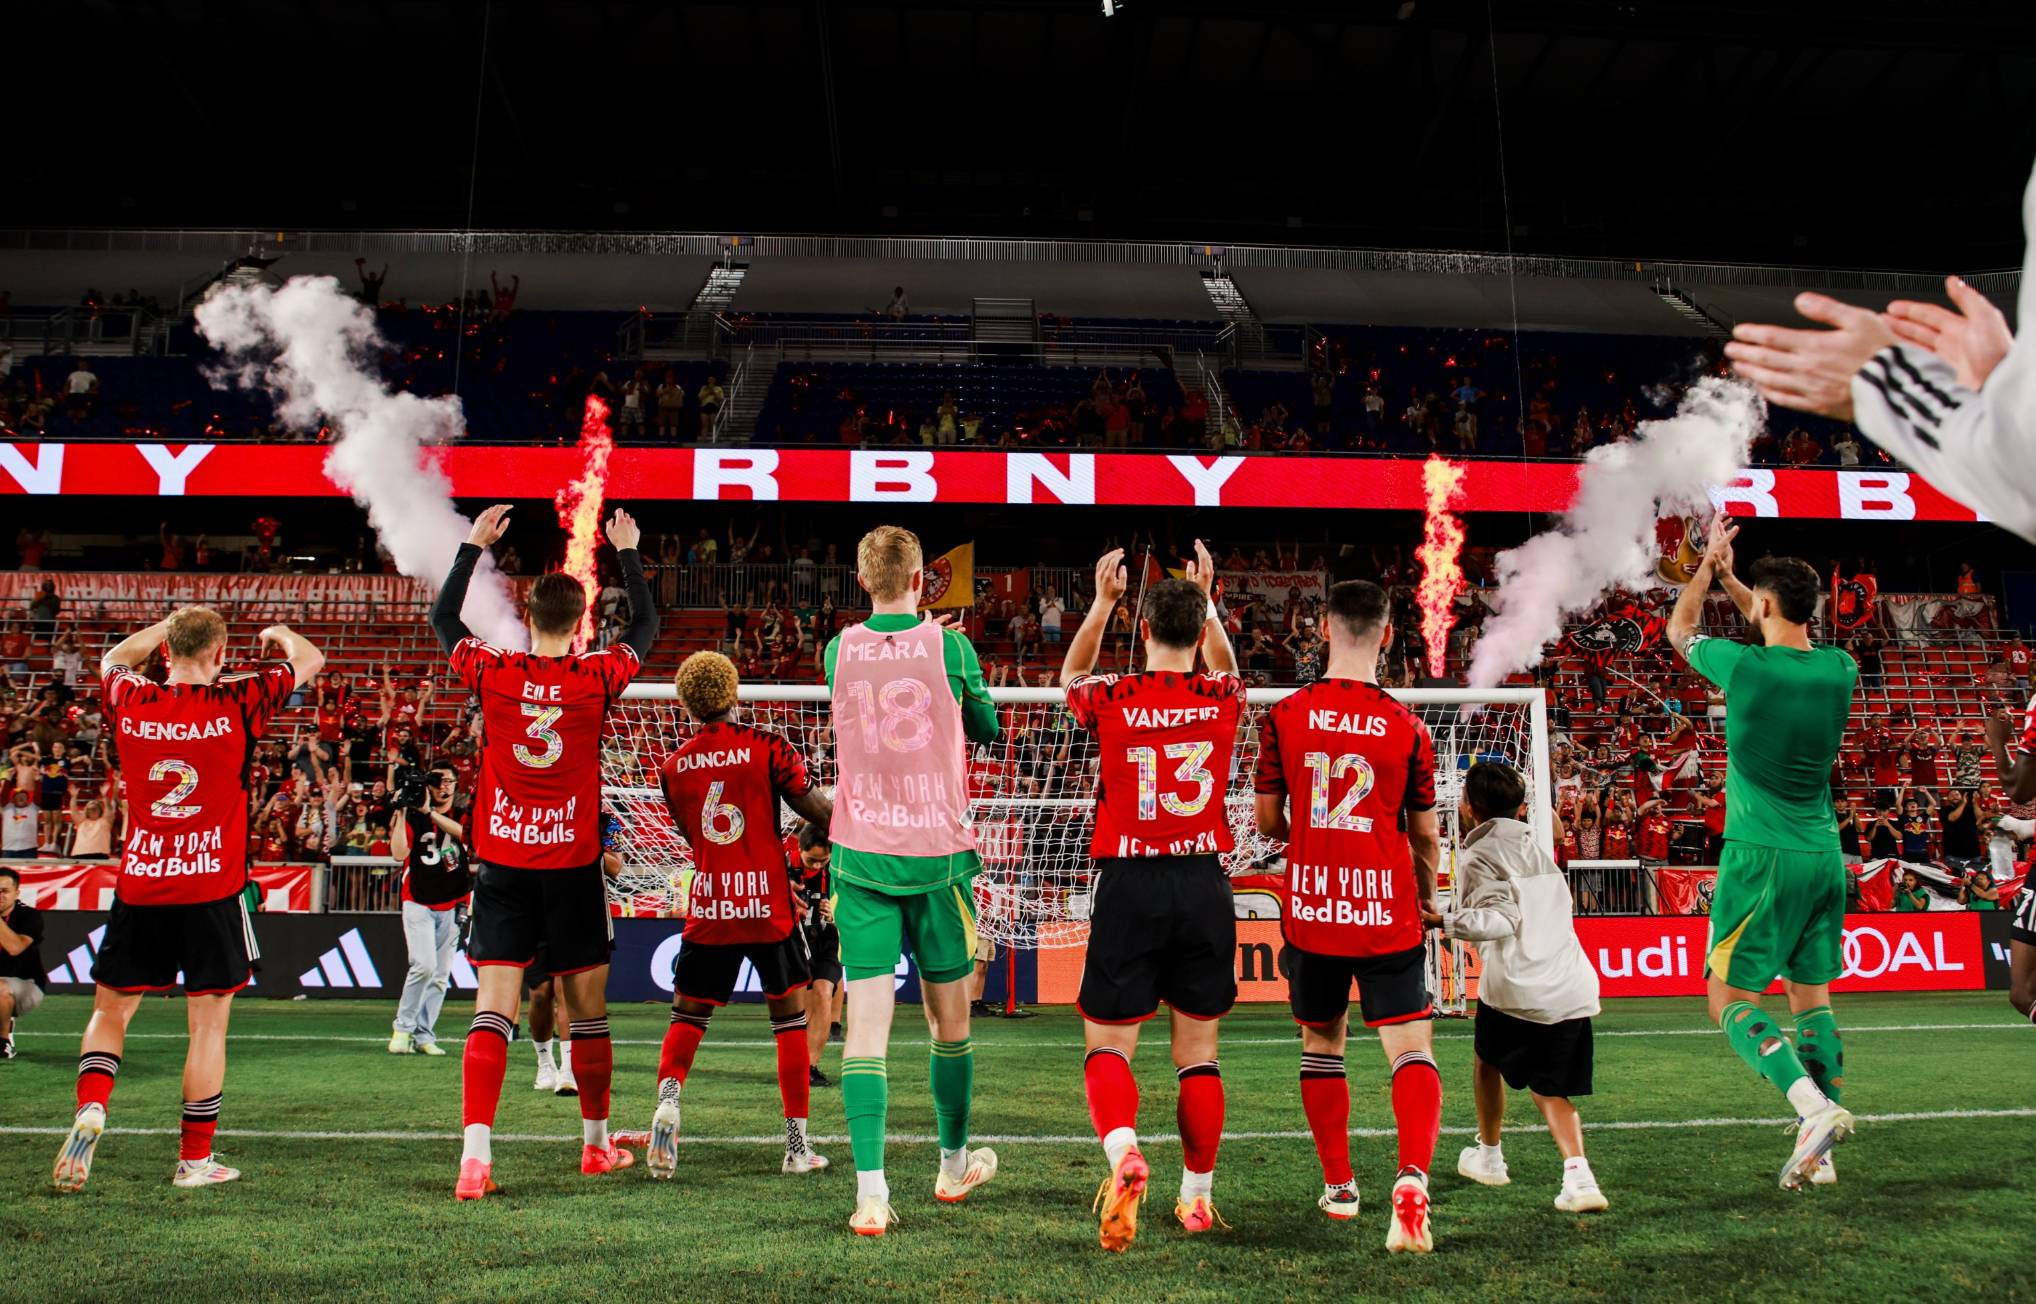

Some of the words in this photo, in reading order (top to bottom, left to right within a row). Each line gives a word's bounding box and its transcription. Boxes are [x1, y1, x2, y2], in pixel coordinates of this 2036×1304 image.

[1706, 468, 1991, 522] RB
[846, 640, 929, 661] MEARA
[522, 681, 562, 701] EILE
[121, 716, 233, 741] GJENGAAR
[846, 678, 934, 754] 18
[1122, 706, 1220, 728] VANZEIR
[1308, 709, 1388, 737] NEALIS
[512, 702, 564, 769] 3
[677, 748, 751, 773] DUNCAN
[149, 759, 202, 818] 2
[1127, 741, 1215, 820] 13
[1304, 752, 1375, 833] 12
[701, 781, 745, 845] 6
[489, 815, 521, 843] Red
[523, 822, 575, 845] Bulls
[125, 853, 164, 878] Red
[165, 852, 221, 877] Bulls
[692, 872, 713, 897] NEW
[721, 870, 769, 897] YORK
[1292, 863, 1328, 895] NEW
[1339, 867, 1393, 899] YORK
[691, 898, 718, 920] Red
[720, 898, 771, 920] Bulls
[1292, 895, 1332, 923] Red
[1335, 900, 1393, 926] Bulls
[1599, 935, 1688, 978] udi
